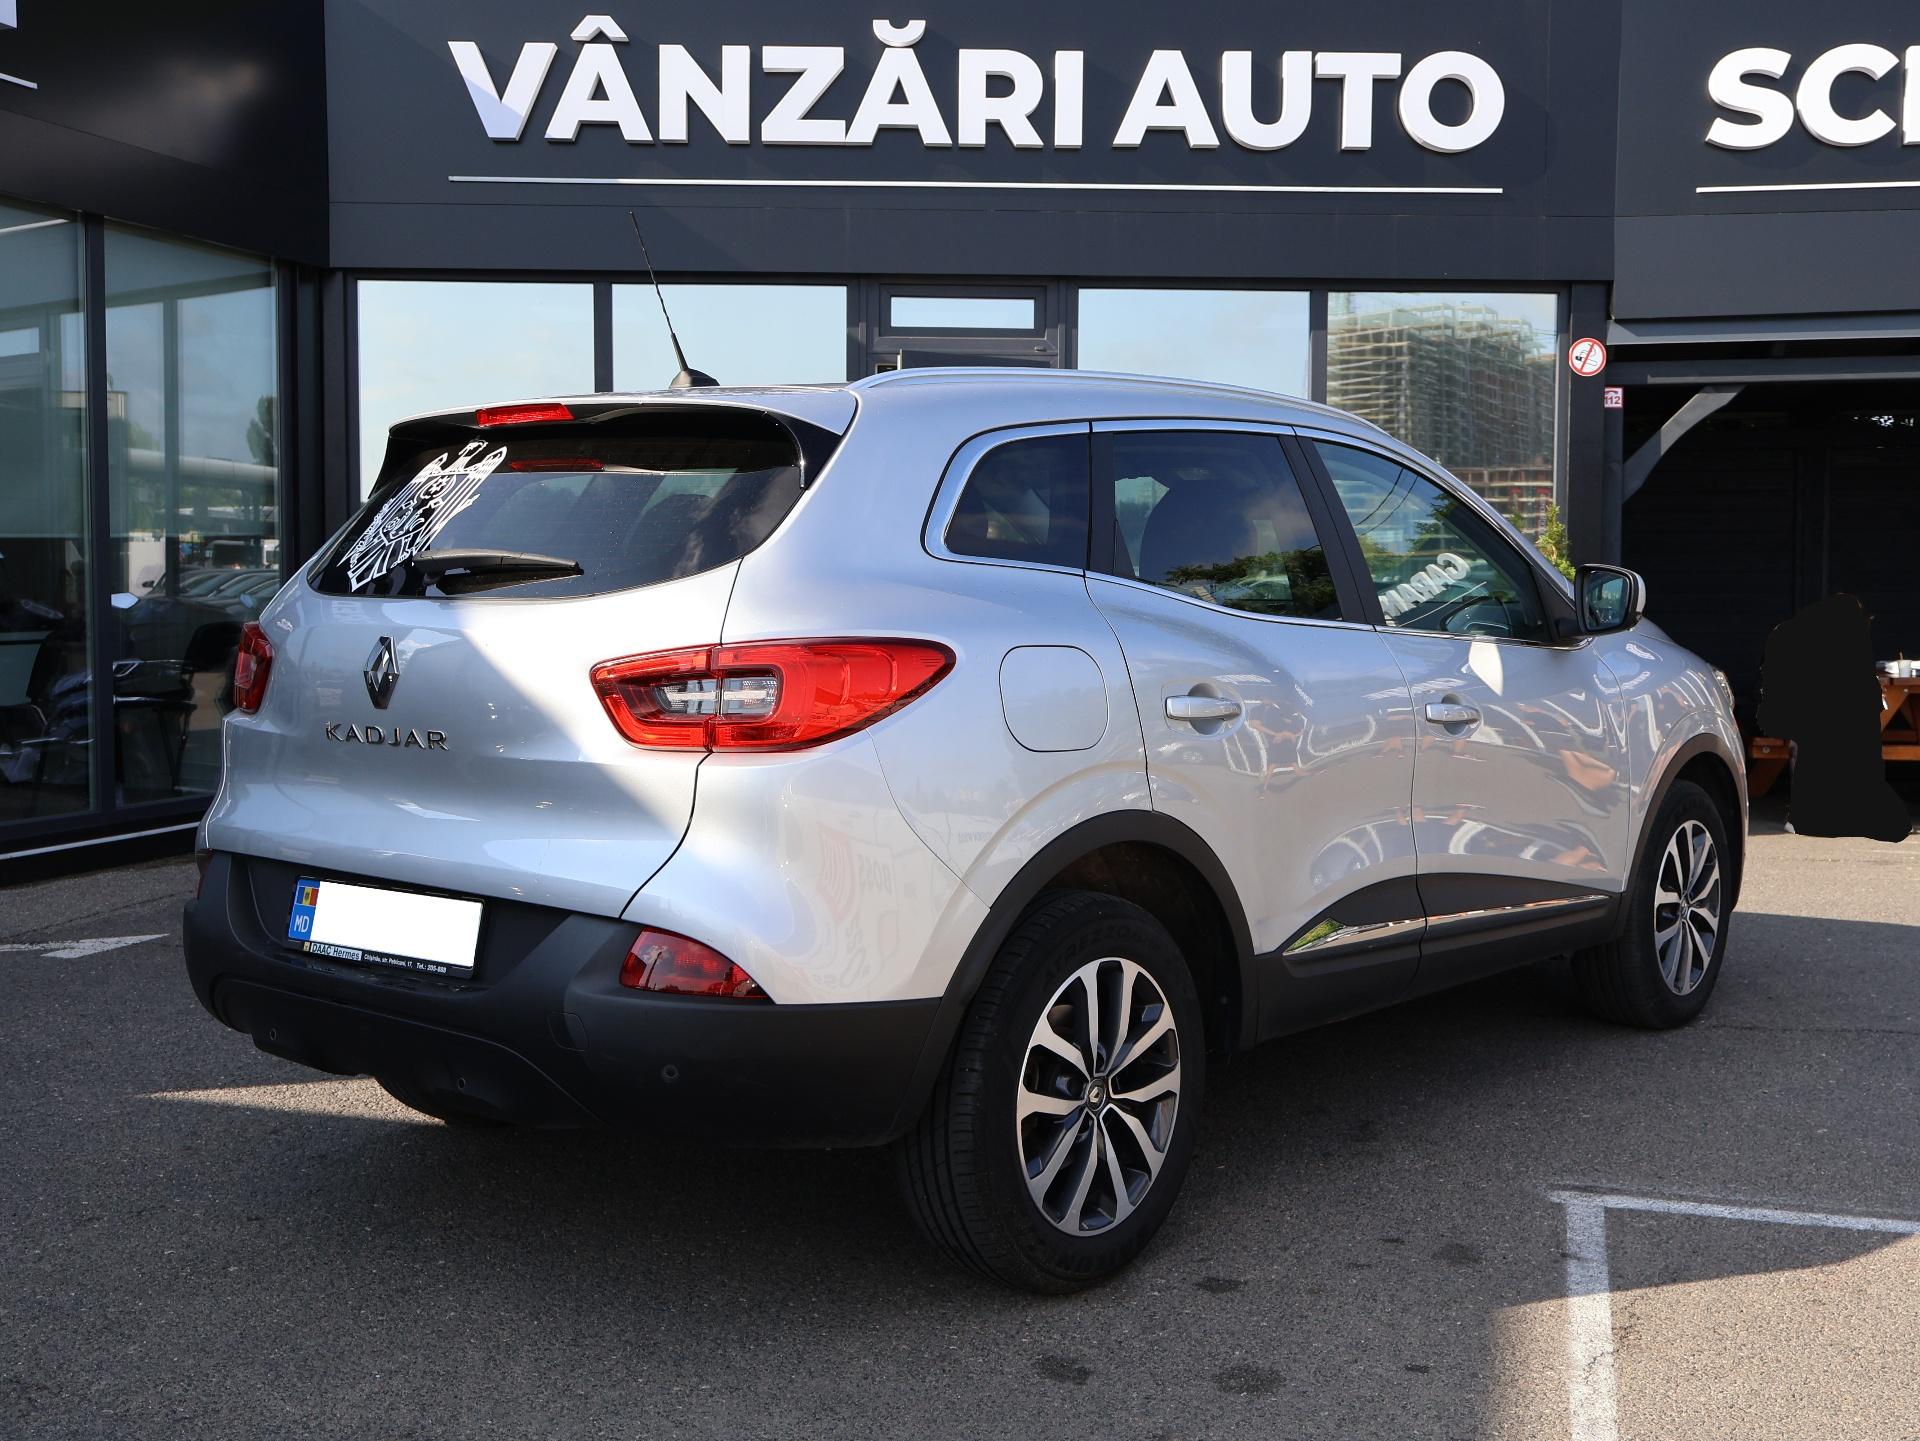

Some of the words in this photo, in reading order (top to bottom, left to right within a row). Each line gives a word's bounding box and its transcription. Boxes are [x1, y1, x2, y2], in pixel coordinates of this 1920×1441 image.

[448, 15, 1084, 148] VÂNZĂRI
[1112, 50, 1505, 153] AUTO
[1704, 44, 1920, 149] SC
[324, 720, 450, 752] KADJAR
[293, 914, 310, 934] MD
[312, 943, 332, 956] DAAC
[332, 946, 361, 961] Hermes
